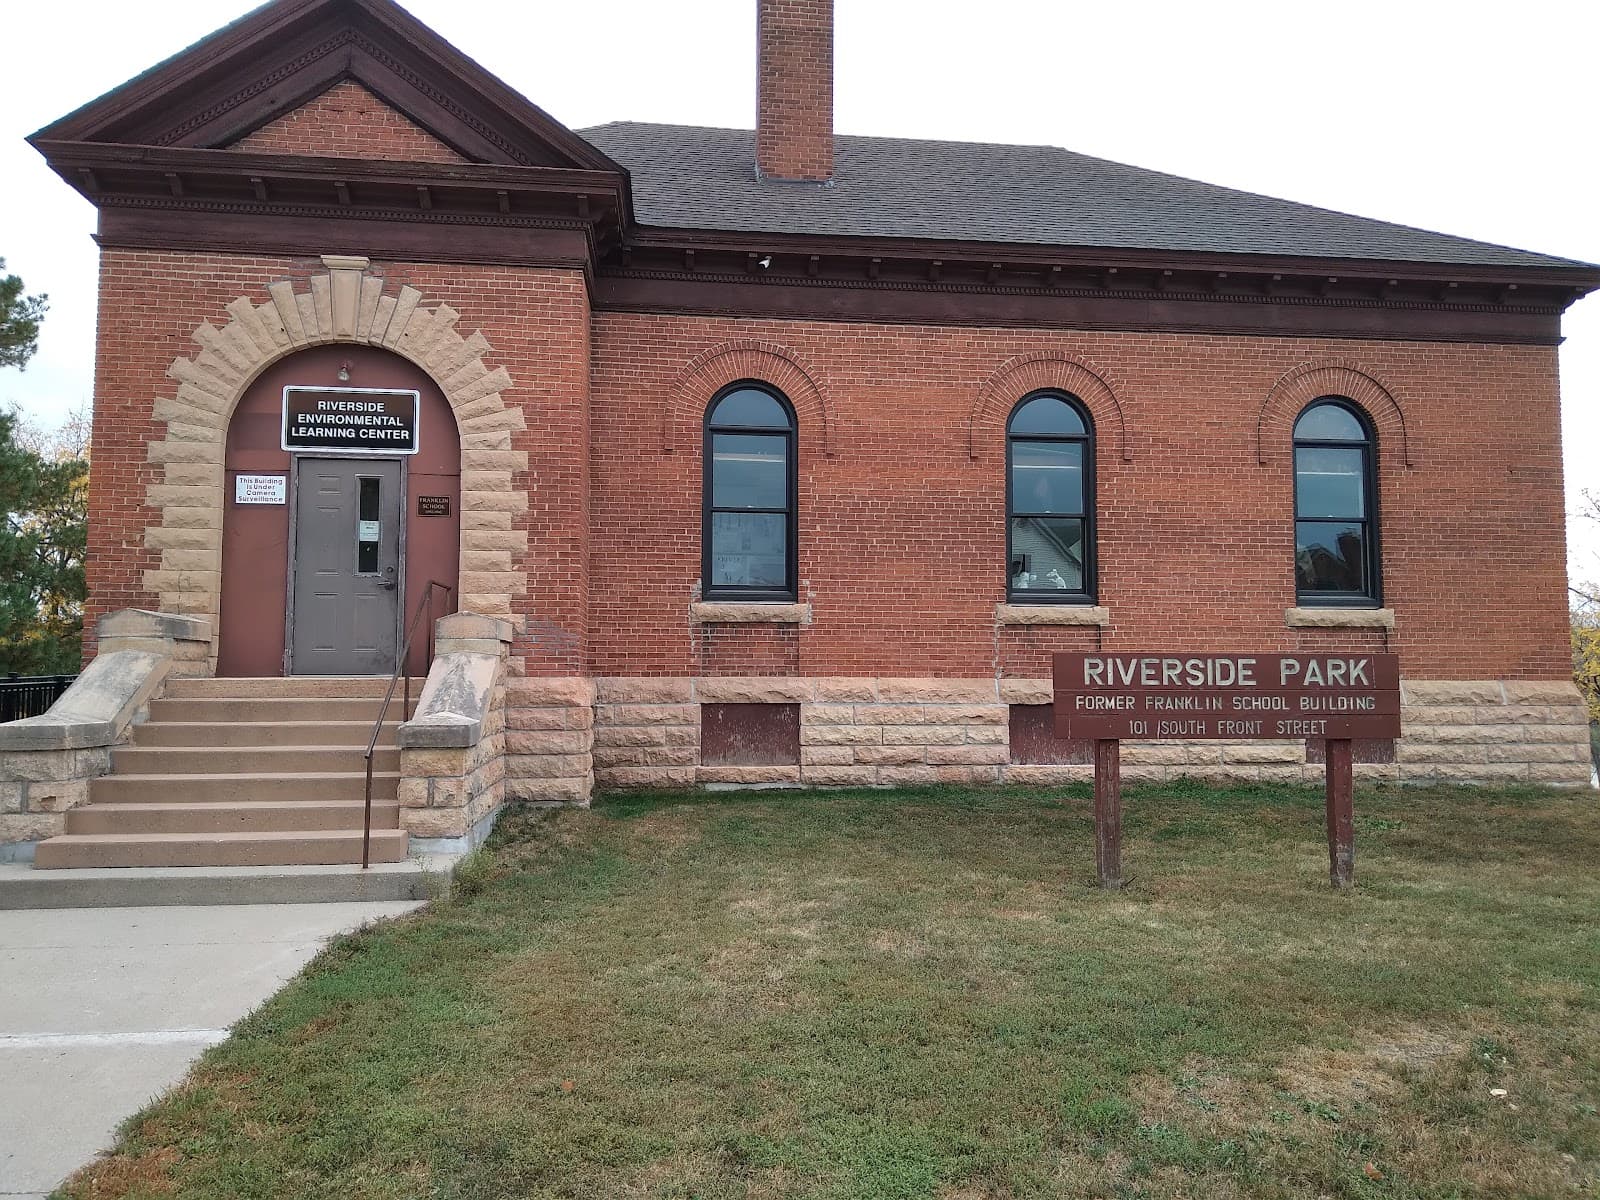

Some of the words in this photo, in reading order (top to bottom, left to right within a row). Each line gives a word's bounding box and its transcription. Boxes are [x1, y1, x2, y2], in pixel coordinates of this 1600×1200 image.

[318, 400, 385, 412] RIVERSIDE
[297, 413, 404, 426] ENVIRONMENTAL
[291, 427, 356, 438] LEARNING
[359, 429, 410, 440] CENTER
[1083, 657, 1257, 687] RIVERSIDE
[1280, 657, 1369, 687] PARK
[1075, 695, 1136, 711] FORMER
[1145, 695, 1223, 711] FRANKLIN
[1232, 695, 1290, 711] SCHOOL
[1300, 695, 1376, 711] BUILDING
[1129, 719, 1149, 735] 101
[1160, 719, 1206, 735] SOUTH
[1217, 719, 1264, 735] FRONT
[1276, 719, 1328, 735] STREET
